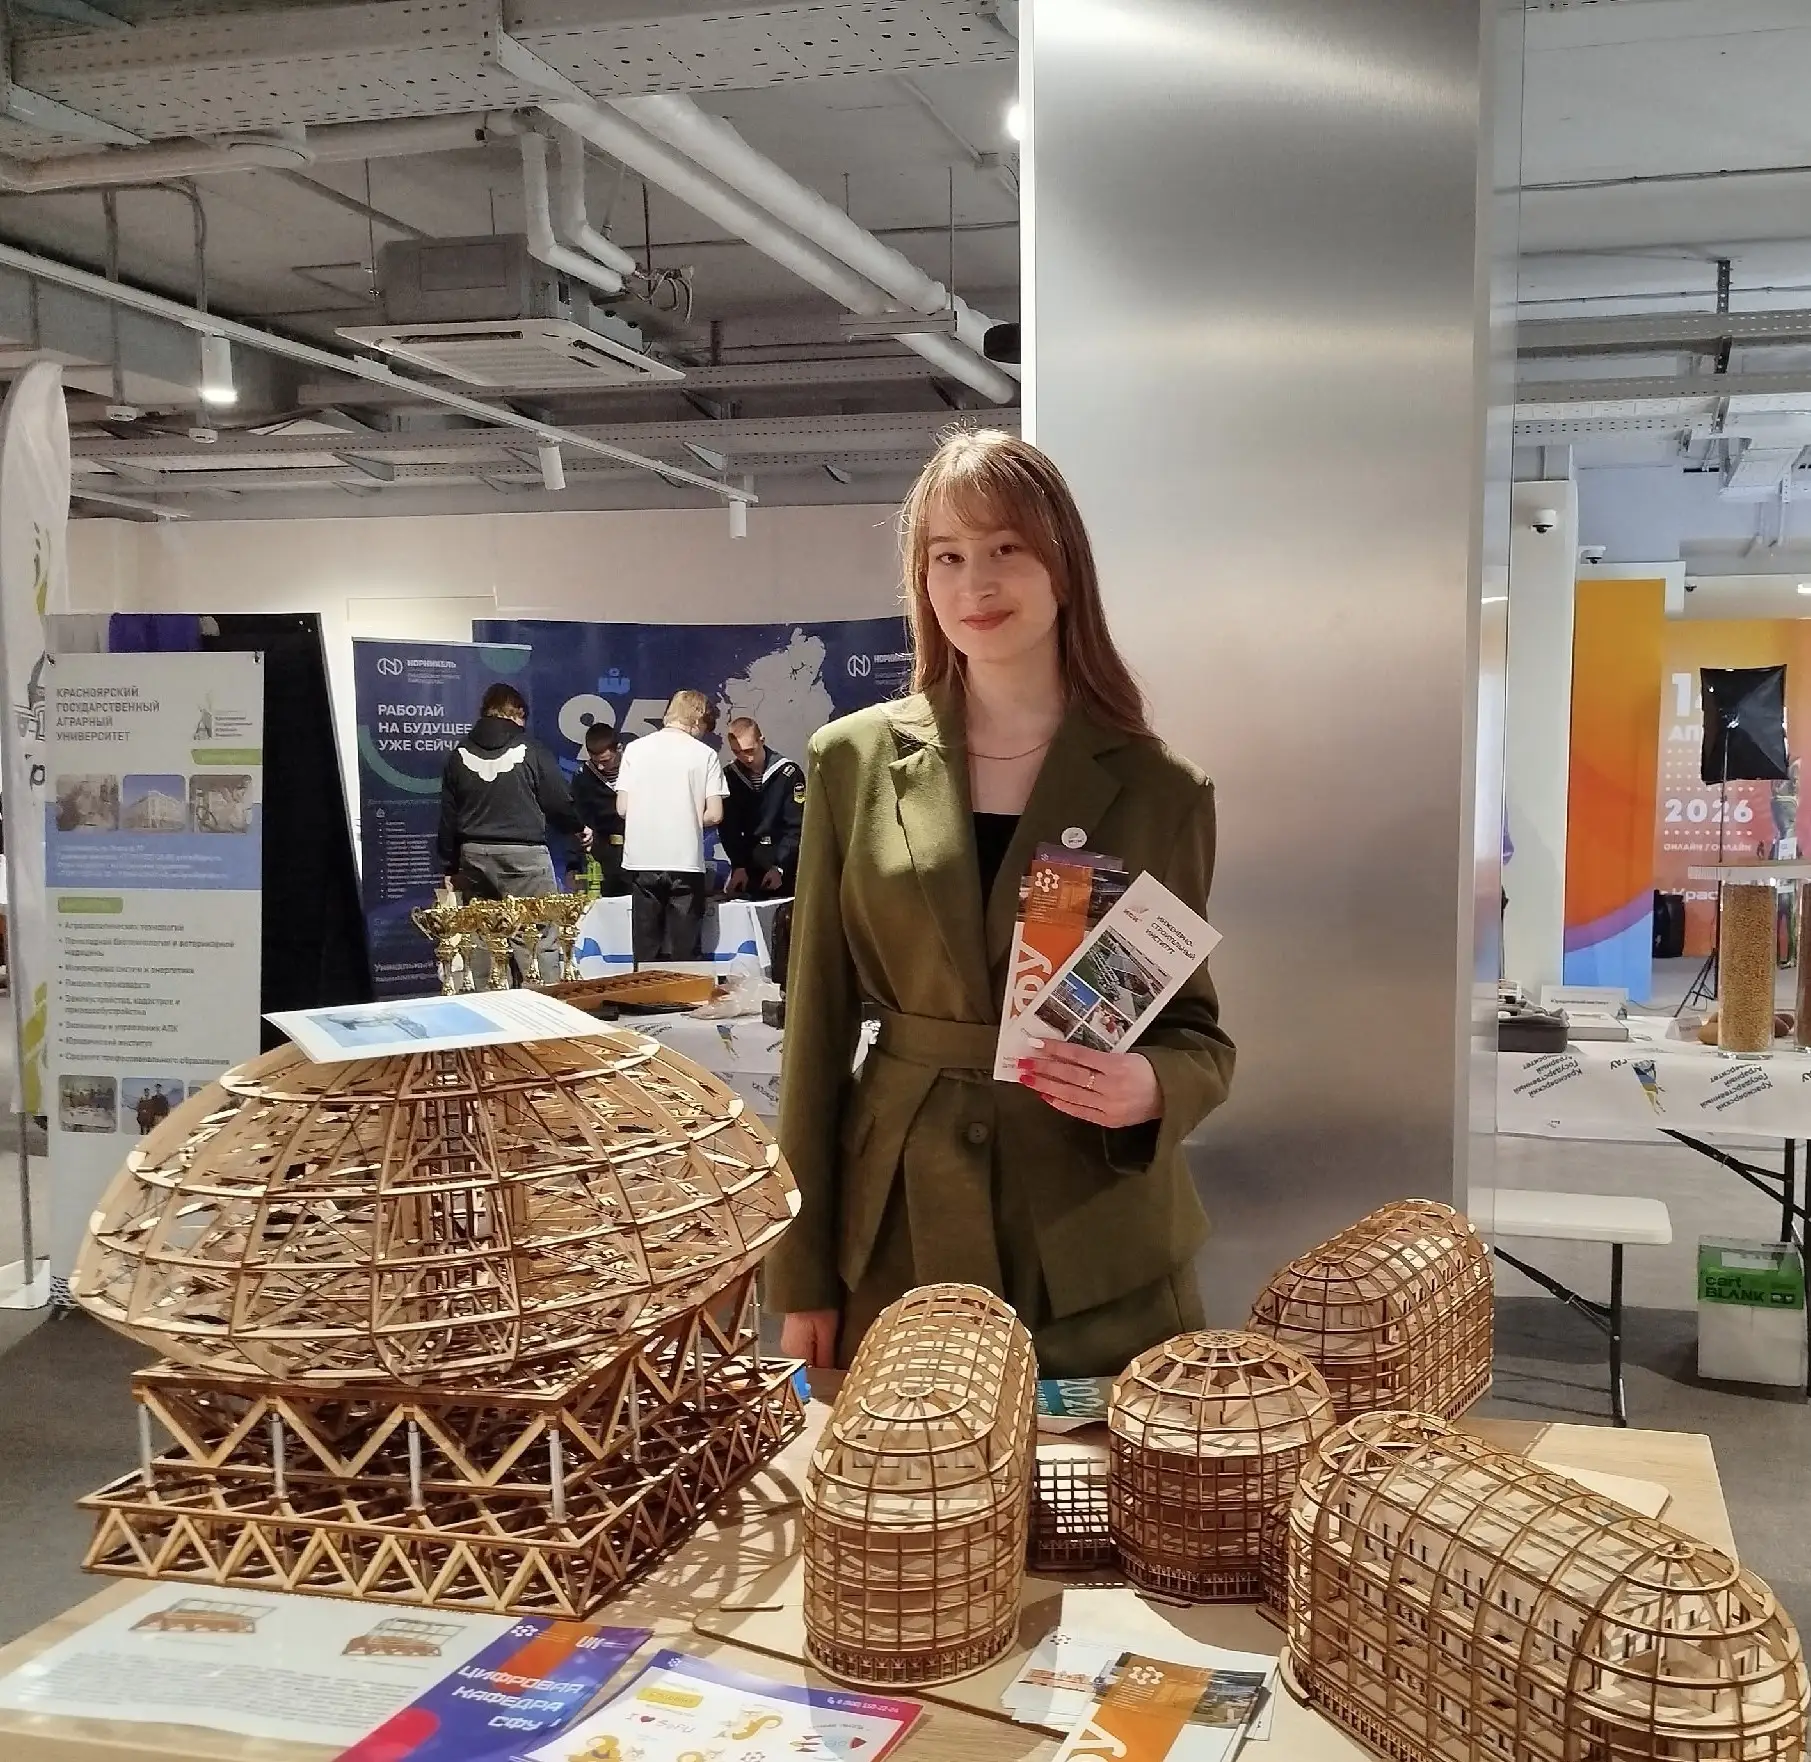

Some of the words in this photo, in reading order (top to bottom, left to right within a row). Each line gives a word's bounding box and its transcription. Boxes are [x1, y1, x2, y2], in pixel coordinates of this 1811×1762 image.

[56, 685, 139, 698] КРАСНОЯРСКИЙ
[1671, 672, 1702, 717] 1
[56, 700, 160, 713] ГОСУДАРСТВЕННЫЙ
[377, 704, 445, 717] РАБОТАЙ
[56, 715, 113, 727] АГРАРНЫЙ
[378, 722, 400, 733] НА
[403, 722, 473, 736] БУДУЩЕЕ
[56, 731, 130, 741] УНИВЕРСИТЕТ
[1667, 723, 1702, 742] АП
[378, 739, 411, 751] УЖЕ
[414, 738, 460, 751] СЕЙЧ
[1664, 798, 1754, 824] 2026
[1663, 841, 1703, 851] ОНЛАЙН
[1671, 887, 1719, 904] Крас
[1145, 928, 1176, 955] ИНСТИТУТ
[1150, 921, 1196, 961] СТРОИТЕЛЬНЫЙ
[1008, 921, 1053, 1019] ФУ
[1528, 1067, 1583, 1099] Красноярский
[1716, 1081, 1773, 1112] Красноярский
[1705, 1276, 1742, 1288] cart
[1705, 1287, 1765, 1302] BLANK
[458, 1665, 585, 1693] ЦИФРОВАЯ
[452, 1686, 566, 1712] КАФЕДРА
[488, 1715, 544, 1731] СФУ
